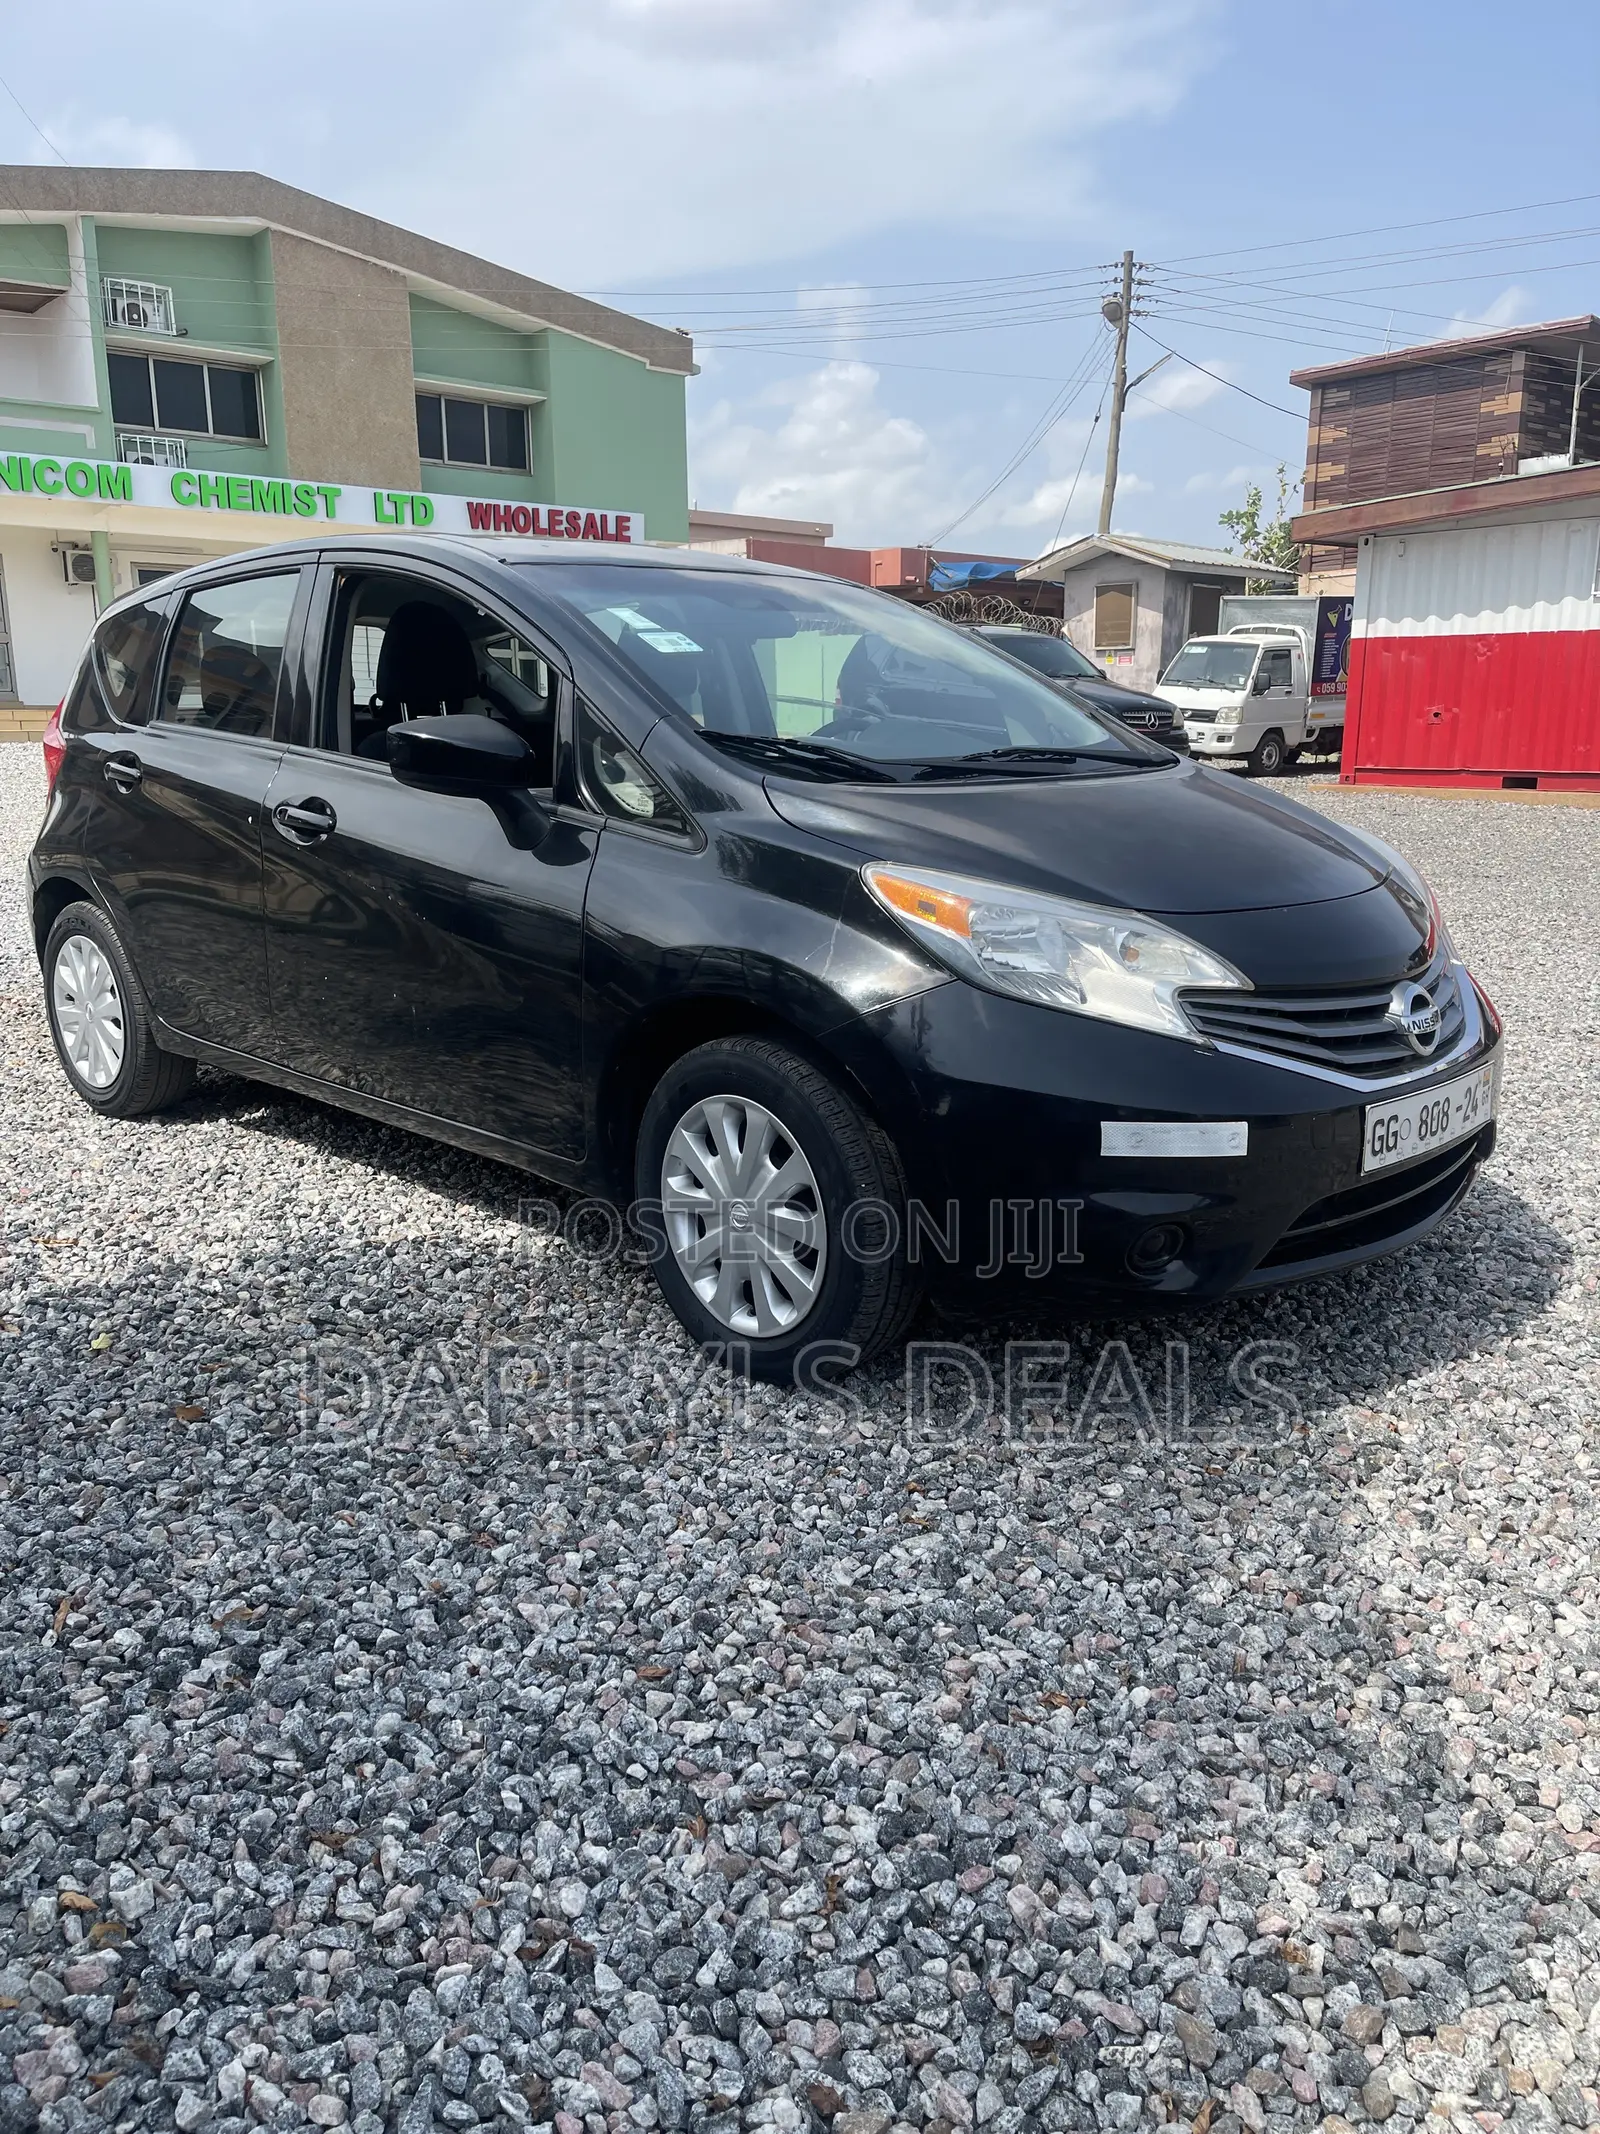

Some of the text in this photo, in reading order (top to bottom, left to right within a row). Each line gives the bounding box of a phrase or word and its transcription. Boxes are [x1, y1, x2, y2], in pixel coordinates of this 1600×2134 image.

[170, 471, 342, 519] CHEMIST
[373, 491, 435, 527] LTD
[466, 501, 632, 543] WHOLESALE
[1321, 682, 1335, 694] 059
[1371, 1114, 1399, 1157] GG
